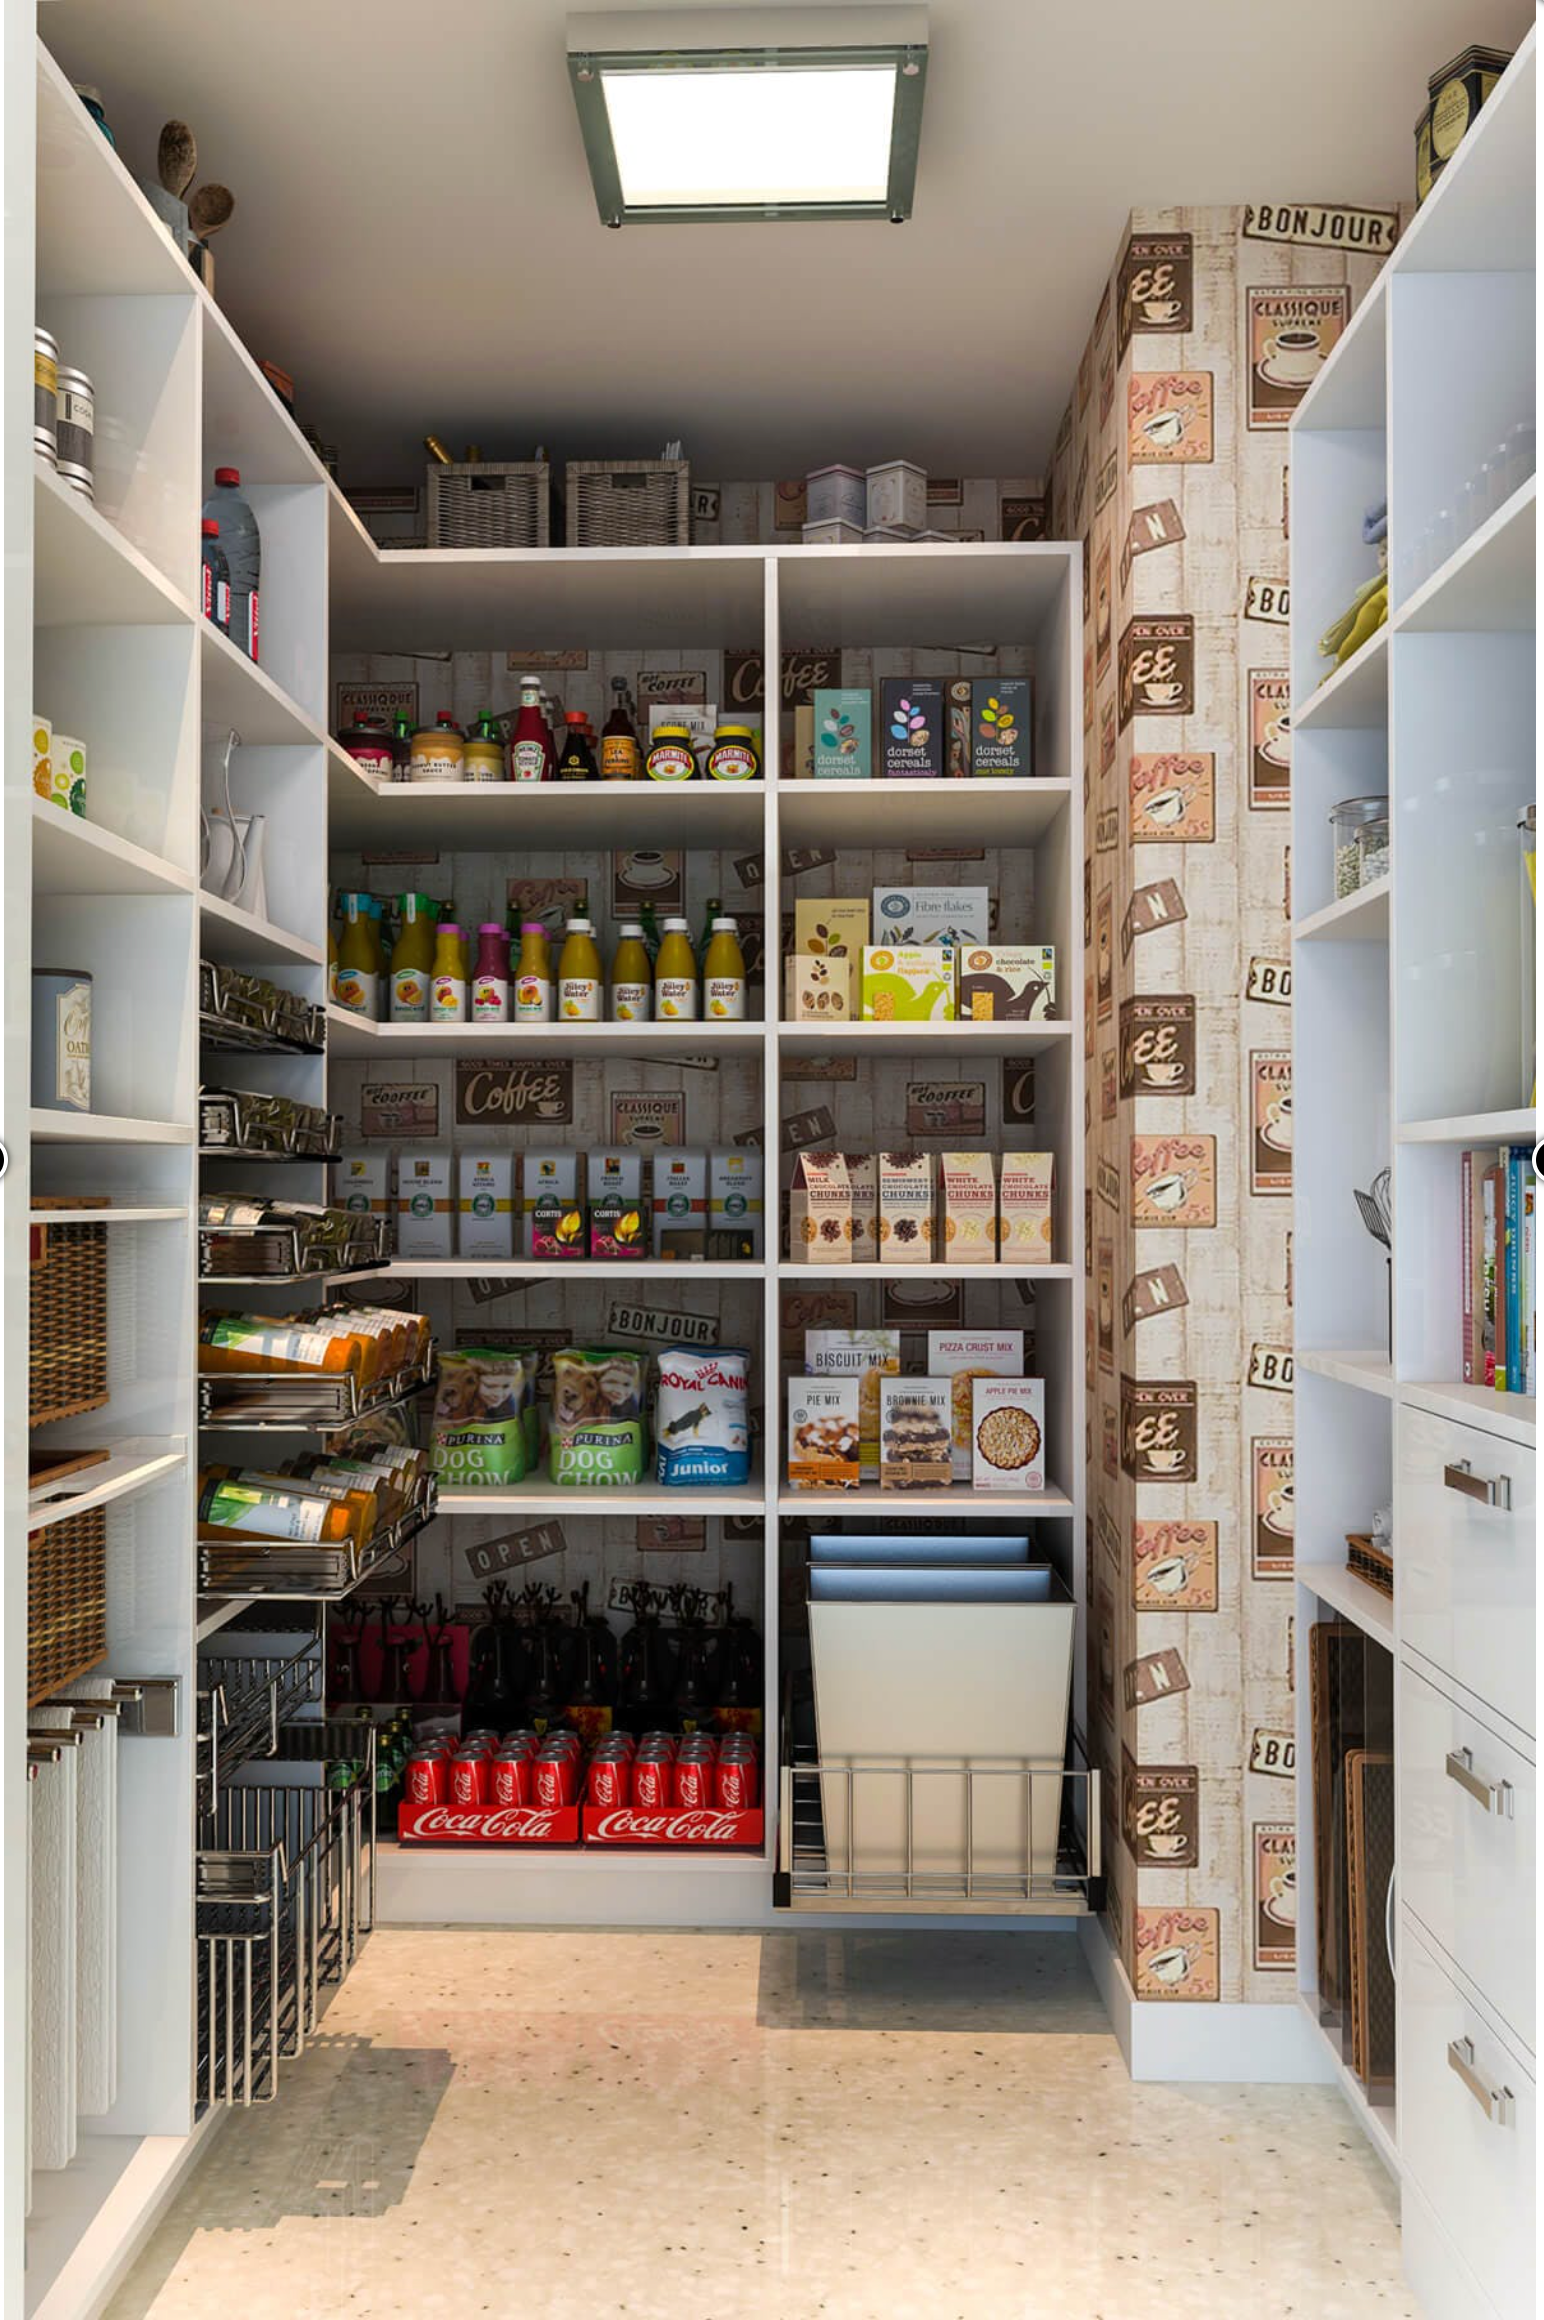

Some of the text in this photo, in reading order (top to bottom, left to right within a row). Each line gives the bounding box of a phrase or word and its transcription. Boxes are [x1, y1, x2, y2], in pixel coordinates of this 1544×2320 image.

[1258, 205, 1382, 246] BONJOUR
[1254, 301, 1342, 318] CLASSIQUE
[651, 749, 690, 763] MARMITE
[713, 749, 752, 763] MARMITE
[887, 747, 926, 757] dorset
[976, 745, 1015, 756] dorset
[818, 755, 856, 766] dorset
[887, 757, 931, 768] cereals
[976, 756, 1020, 767] cereals
[818, 767, 861, 776] cereals
[916, 901, 973, 913] Fibre flakes
[996, 958, 1035, 966] chocolate
[1005, 966, 1021, 974] rice
[616, 1103, 679, 1114] CLASSIQUE
[947, 1190, 994, 1198] CHUNKS
[1002, 1190, 1049, 1198] CHUNKS
[620, 1310, 709, 1341] BONJOUR
[939, 1342, 1014, 1352] PIZZA CRUST MIX
[816, 1353, 889, 1367] BISCUIT MIX
[661, 1372, 705, 1392] ROYAL
[986, 1387, 1032, 1395] APPLE PIE MIX
[807, 1395, 841, 1406] PIE MIX
[886, 1395, 946, 1406] BROWNIE MIX
[449, 1434, 504, 1446] PURINA
[575, 1433, 632, 1446] PURINA
[433, 1450, 484, 1469] DOG
[559, 1450, 613, 1470] DOG
[557, 1471, 638, 1486] CHOW
[477, 1529, 554, 1570] OPEN
[404, 1807, 562, 1838] Coca-Cola
[588, 1809, 748, 1841] Coca-Cola
